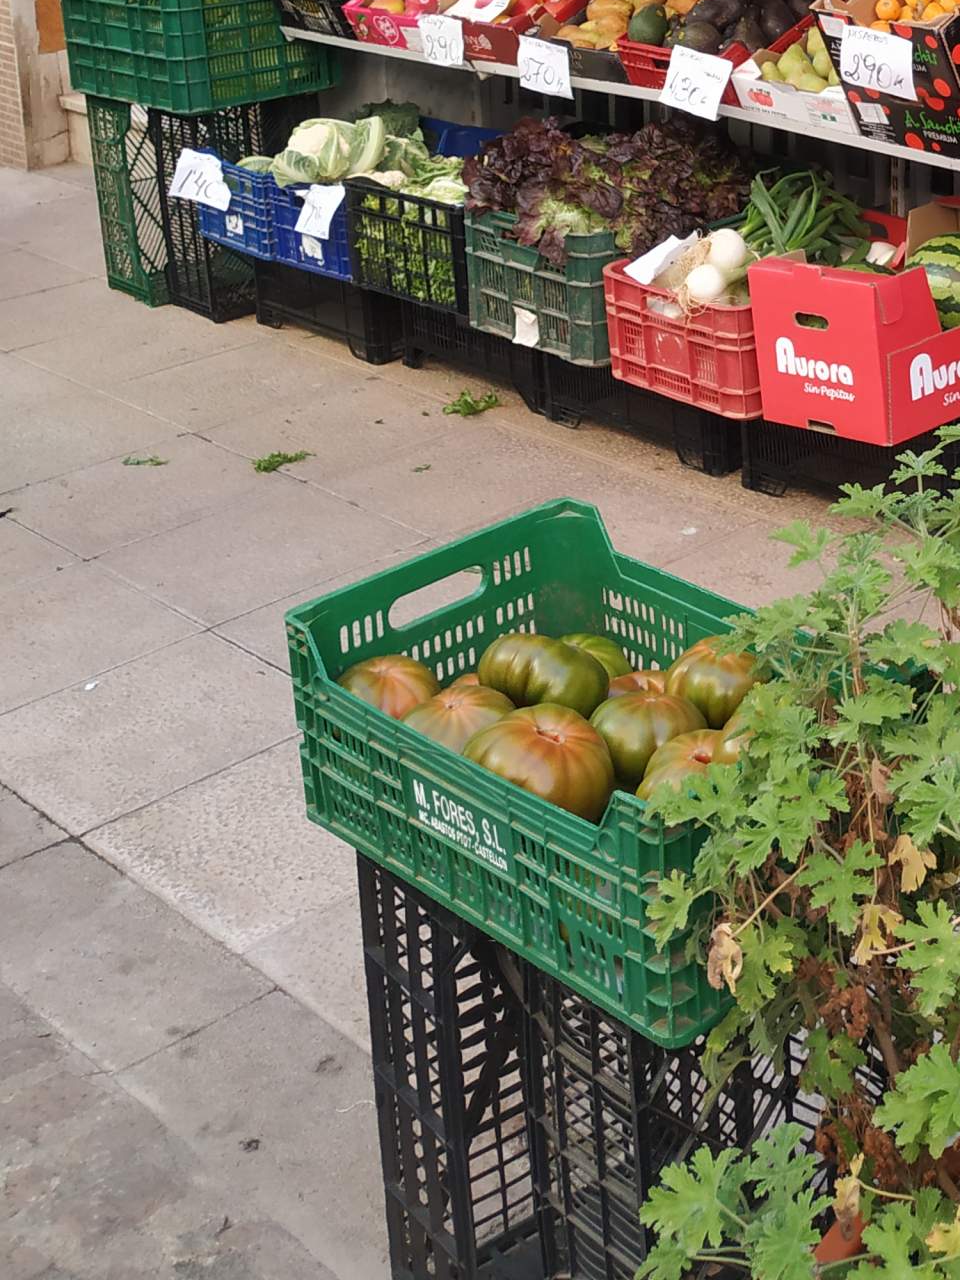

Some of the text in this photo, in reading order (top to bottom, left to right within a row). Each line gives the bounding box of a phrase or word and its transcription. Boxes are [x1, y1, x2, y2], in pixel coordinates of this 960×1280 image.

[923, 130, 959, 145] PREMIUM
[775, 336, 854, 386] Aurora
[413, 779, 431, 810] M.
[432, 790, 480, 844] FORES,
